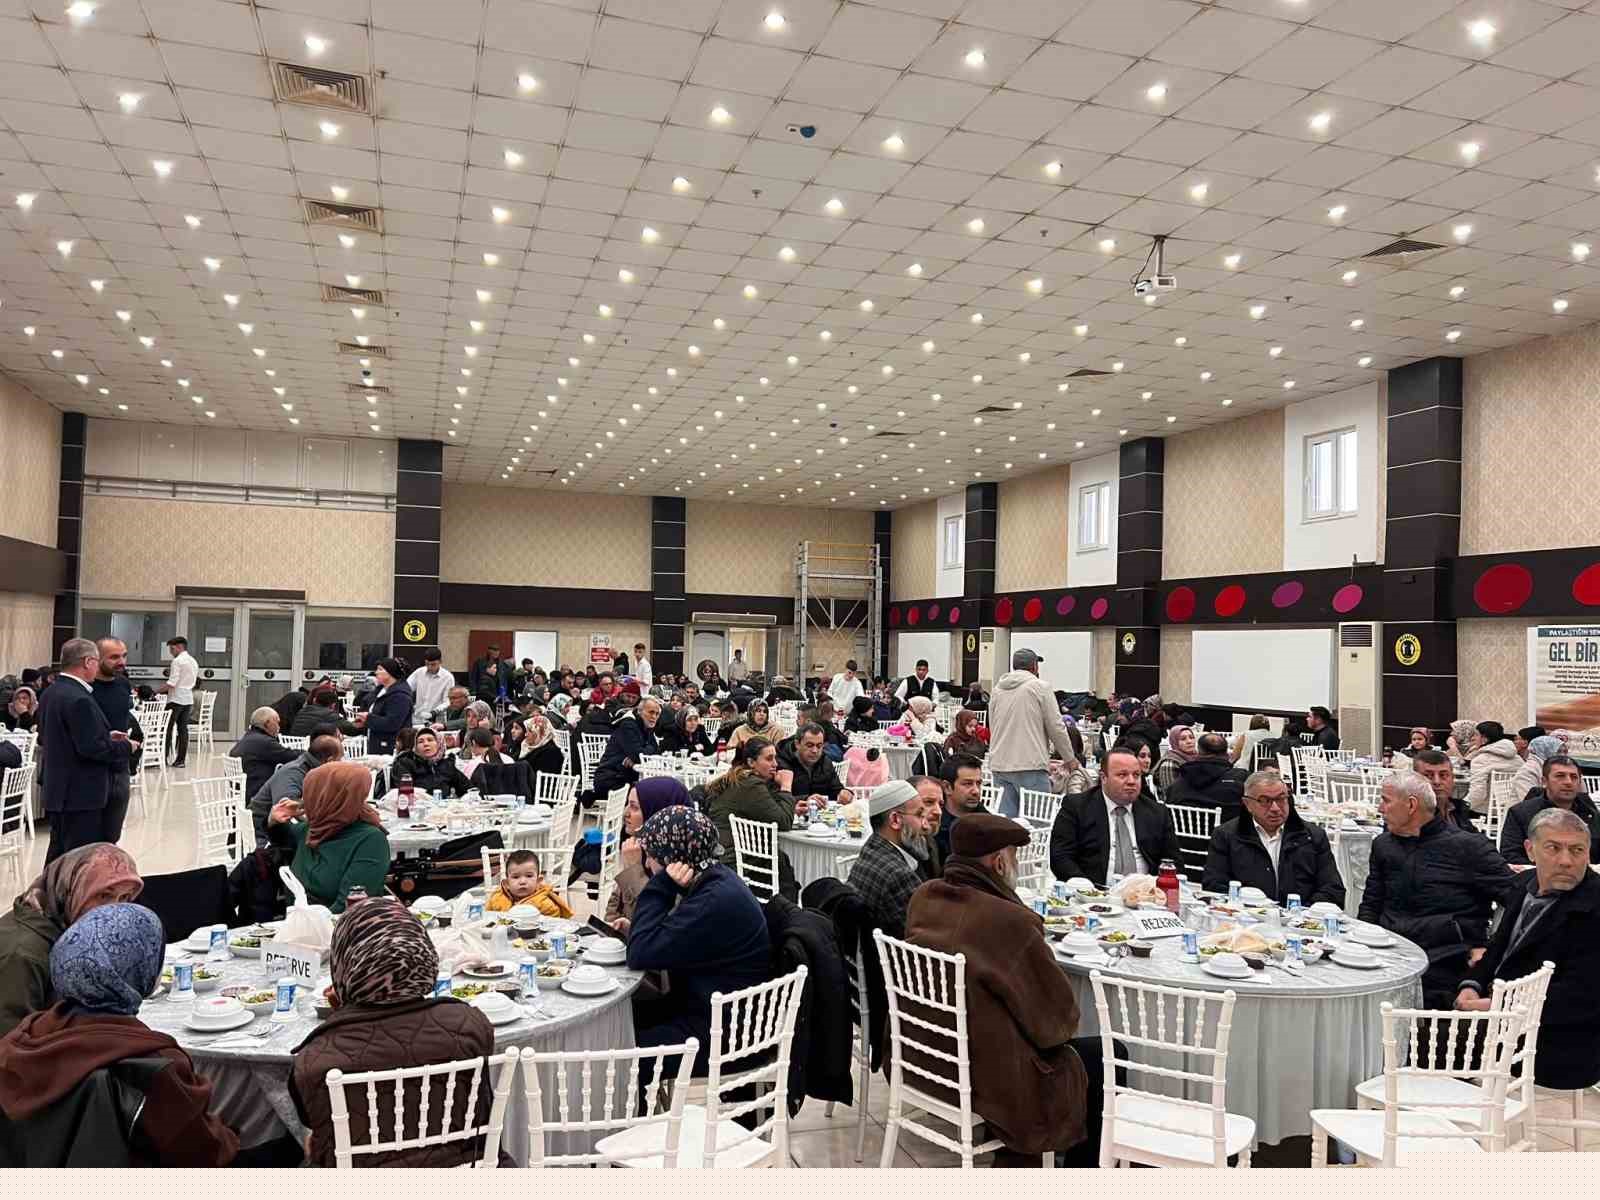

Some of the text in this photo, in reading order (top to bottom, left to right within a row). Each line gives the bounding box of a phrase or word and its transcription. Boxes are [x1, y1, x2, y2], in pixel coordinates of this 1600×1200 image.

[1549, 638, 1598, 662] GEL BİR
[266, 952, 311, 978] RRVE
